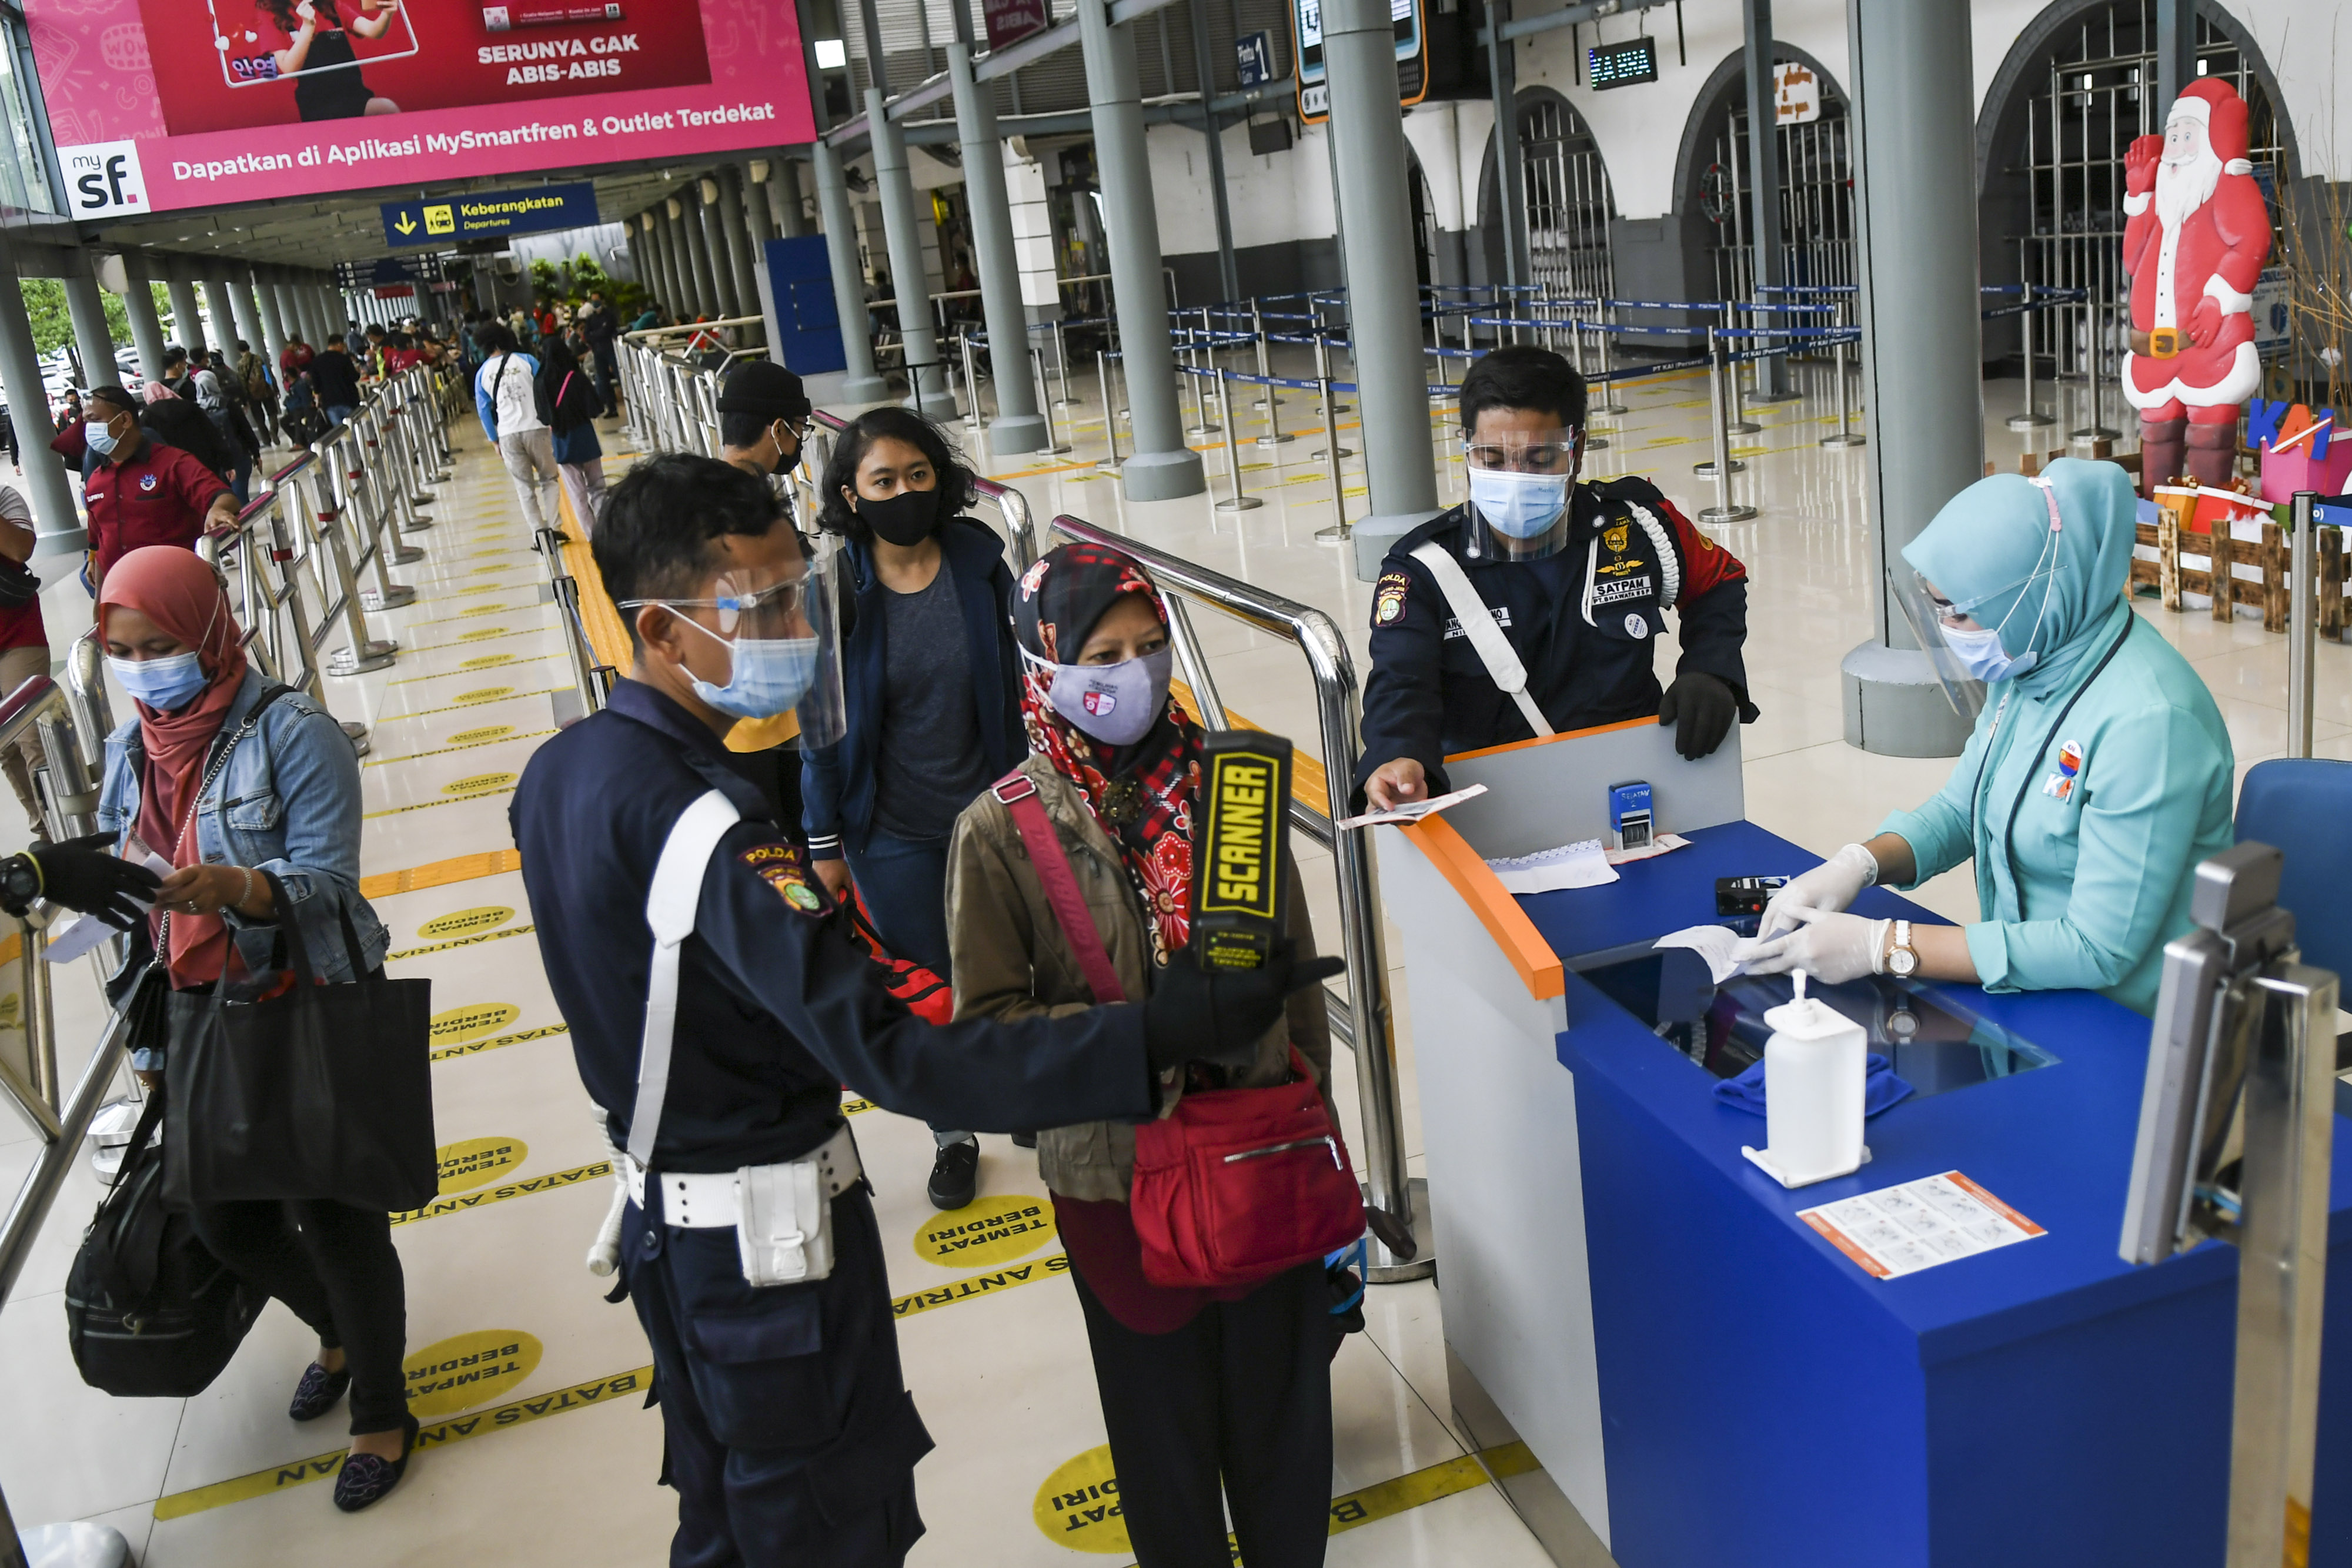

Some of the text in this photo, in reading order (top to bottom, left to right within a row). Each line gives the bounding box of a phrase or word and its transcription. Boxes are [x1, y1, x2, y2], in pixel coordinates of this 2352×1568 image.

[477, 34, 639, 64] SERUNYA GAK
[1255, 36, 1269, 81] 1
[506, 58, 622, 85] ABIS-ABIS
[172, 102, 775, 181] Dapatkan di Aplikasi MySmartfren & Outlet Terdekat
[73, 155, 101, 170] my
[461, 196, 564, 217] Keberangkatan
[464, 218, 510, 230] Departures
[1675, 359, 1703, 369] (Persero)
[2247, 398, 2334, 461] KAI
[1379, 573, 1406, 585] POLDA
[1597, 578, 1644, 596] SATPAM
[1086, 701, 1095, 711] 9
[1217, 764, 1267, 902] SCANNER
[745, 847, 796, 863] POLDA
[429, 911, 505, 929] BERDIRI
[429, 917, 502, 934] TEMPAT
[430, 1009, 507, 1029] BERDIR
[430, 1018, 505, 1037] TEMPA
[496, 1025, 569, 1045] ATAS
[439, 1156, 512, 1179] TEMP
[390, 1163, 610, 1226] BATAS ANTR
[928, 1206, 1041, 1243] BERDIRI
[937, 1219, 1047, 1255] TEMPAT
[893, 1265, 1033, 1315] ANTRIA
[407, 1343, 520, 1381] BERDIR
[495, 1375, 637, 1426] BATAS
[1051, 1478, 1118, 1511] DIRI
[1065, 1503, 1124, 1532] PAT
